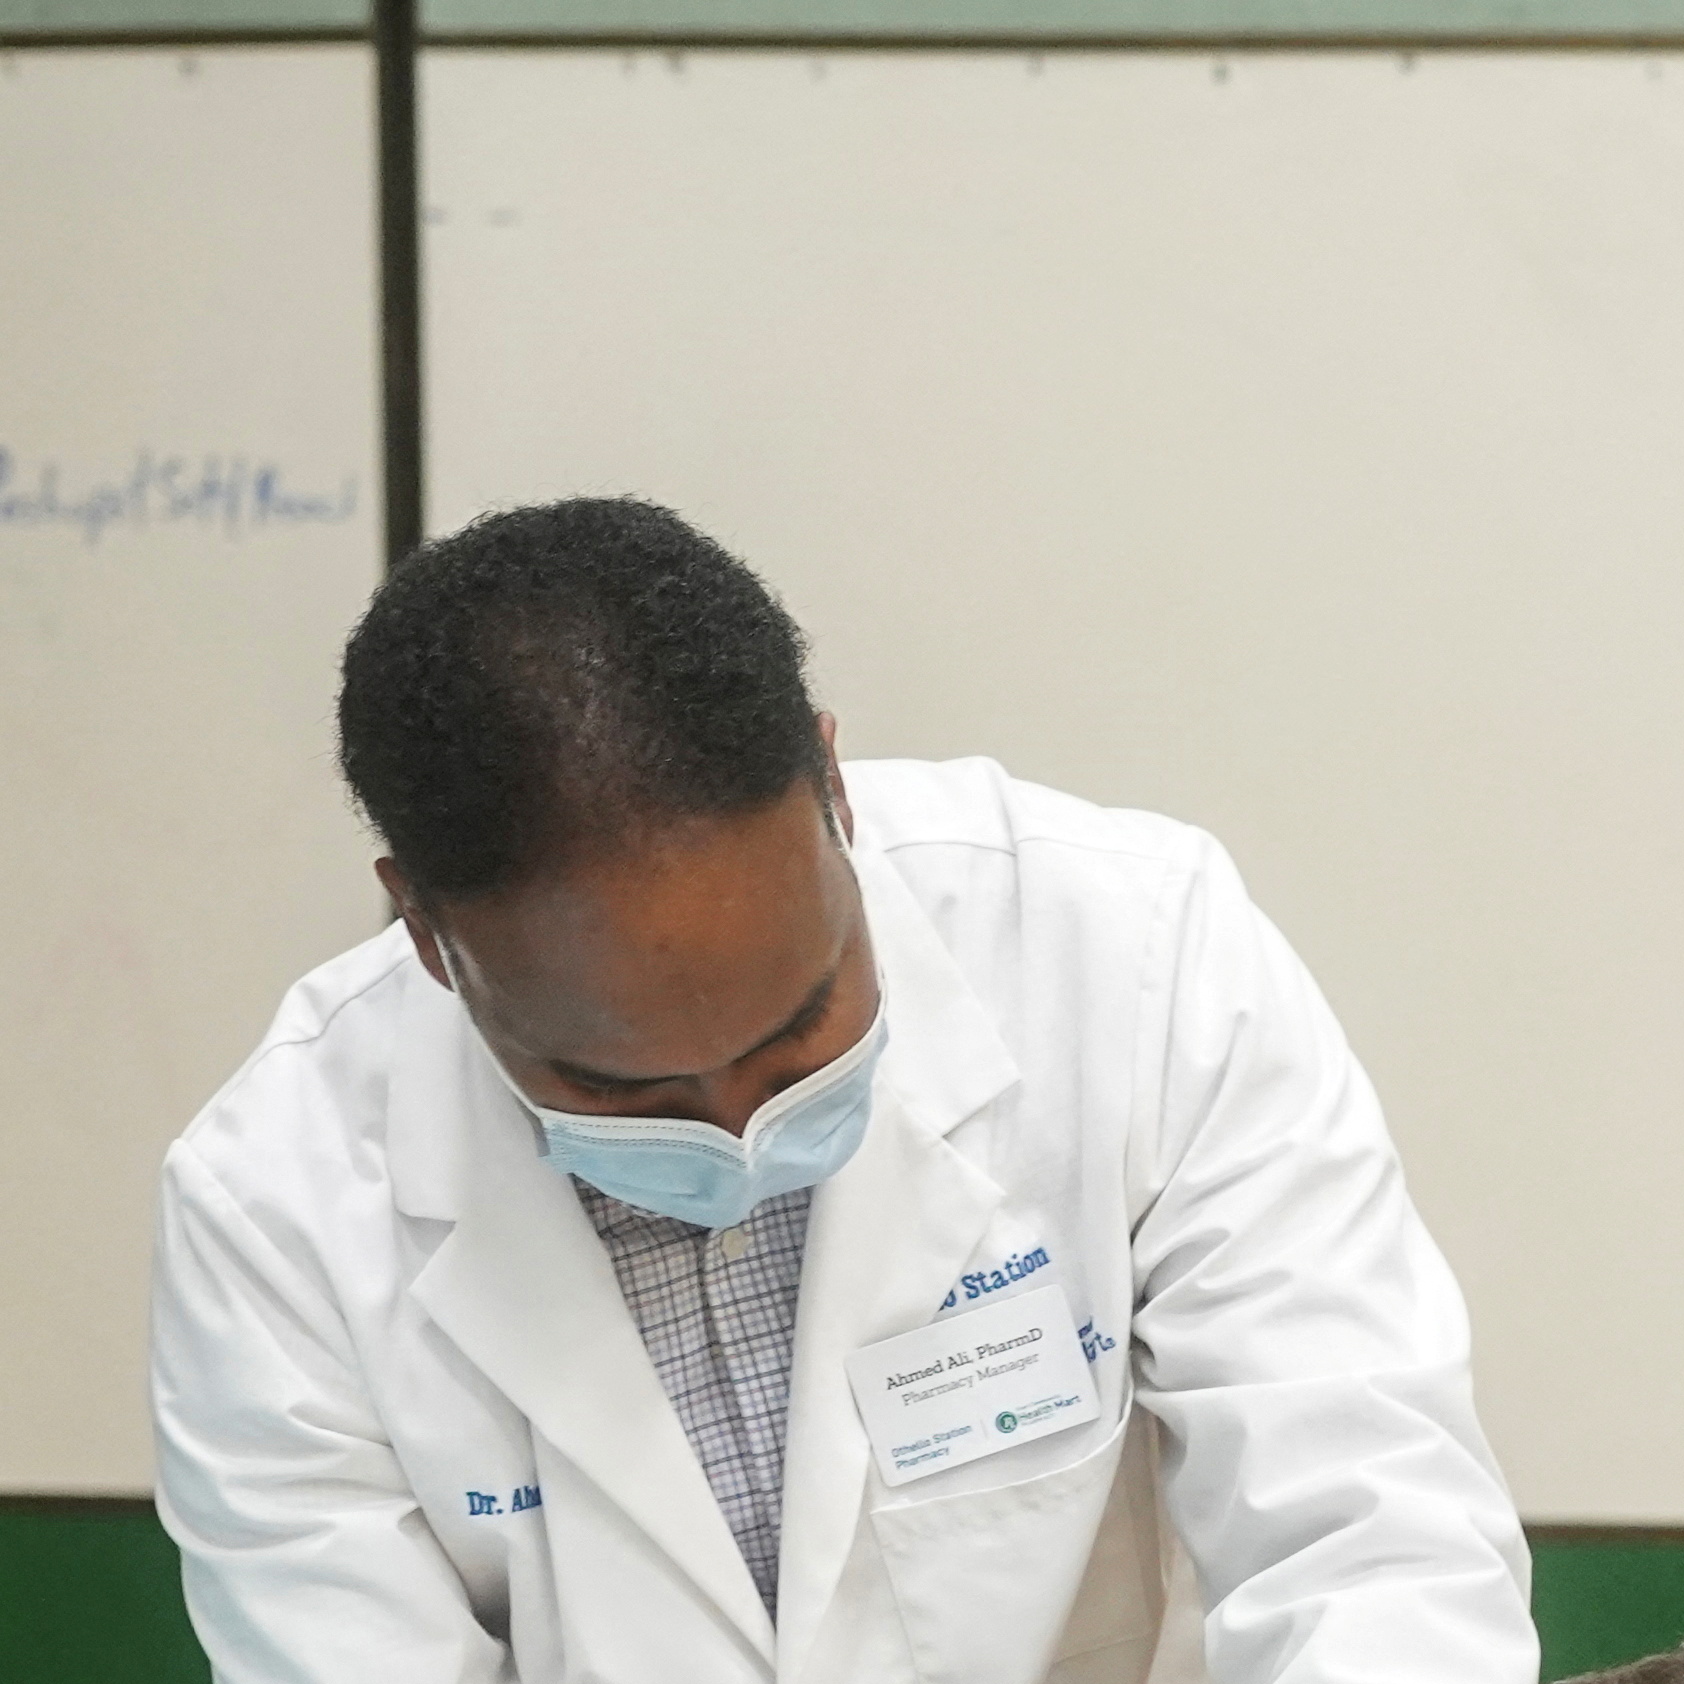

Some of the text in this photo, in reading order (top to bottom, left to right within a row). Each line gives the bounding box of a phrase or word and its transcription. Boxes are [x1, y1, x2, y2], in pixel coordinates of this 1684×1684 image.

[961, 1247, 1050, 1300] Station
[886, 1360, 944, 1391] Ahmed
[948, 1351, 974, 1370] Ali,
[975, 1327, 1043, 1360] PharmD
[901, 1353, 1039, 1406] Pharmacy Manager
[894, 1446, 950, 1470] Pharmacy
[465, 1490, 503, 1516] Dr.
